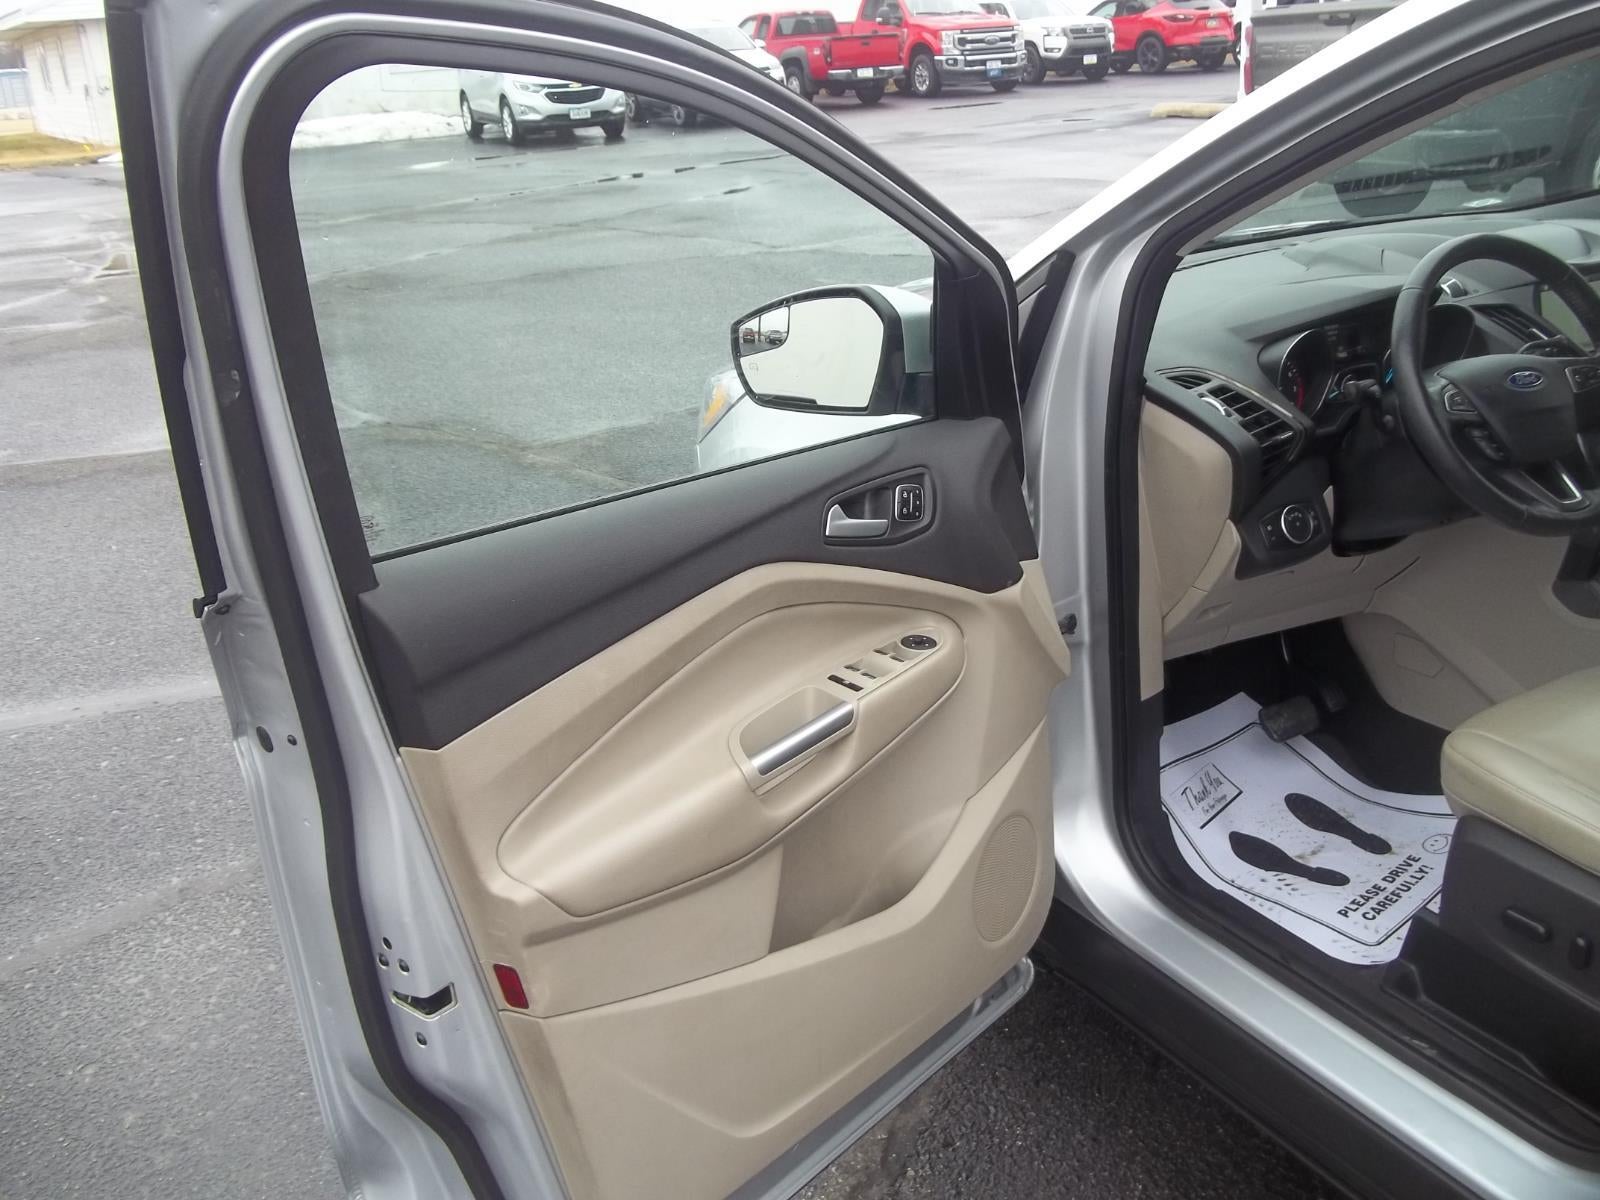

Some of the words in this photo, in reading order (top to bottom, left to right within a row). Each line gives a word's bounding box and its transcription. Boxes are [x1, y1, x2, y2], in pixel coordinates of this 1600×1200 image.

[1337, 883, 1388, 919] PLEASE
[1381, 854, 1422, 884] DRIVE
[1361, 864, 1435, 921] CAREFULLY!
